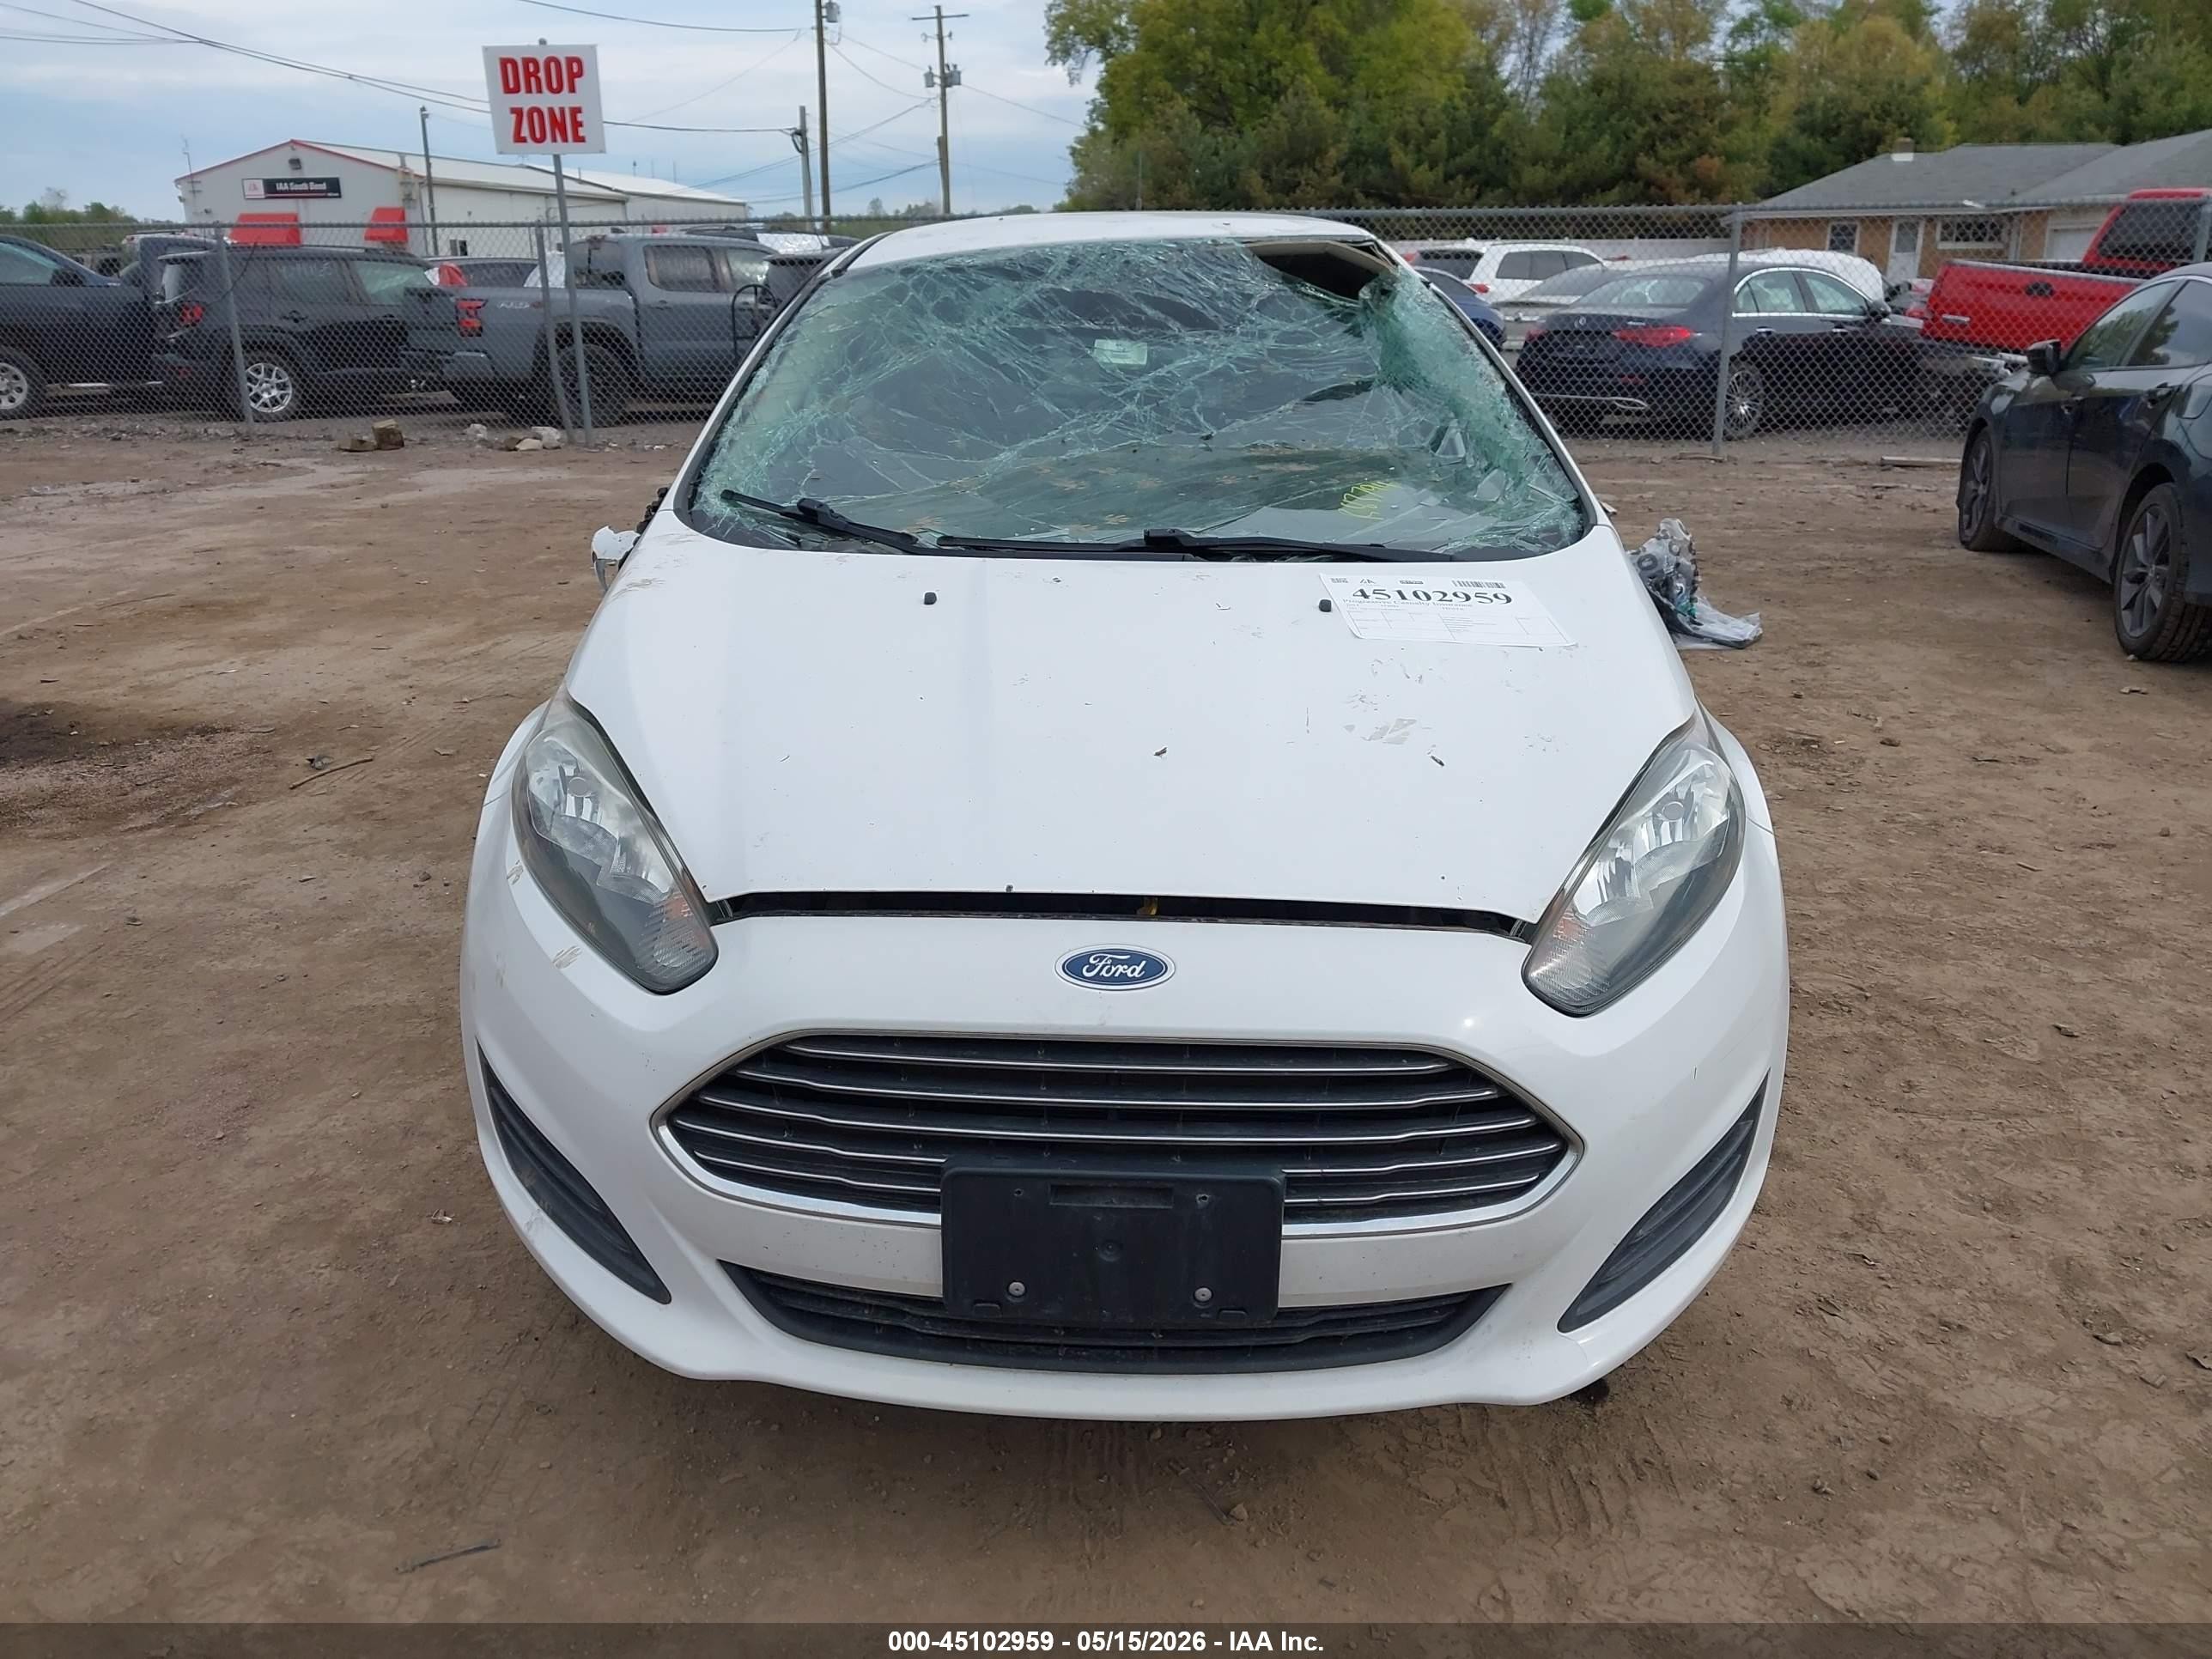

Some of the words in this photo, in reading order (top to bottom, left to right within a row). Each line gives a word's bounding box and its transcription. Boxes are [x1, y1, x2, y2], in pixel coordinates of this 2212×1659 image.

[499, 56, 584, 94] DROP
[510, 106, 586, 144] ZONE
[1352, 588, 1513, 605] 45102959
[1082, 953, 1146, 977] Ford
